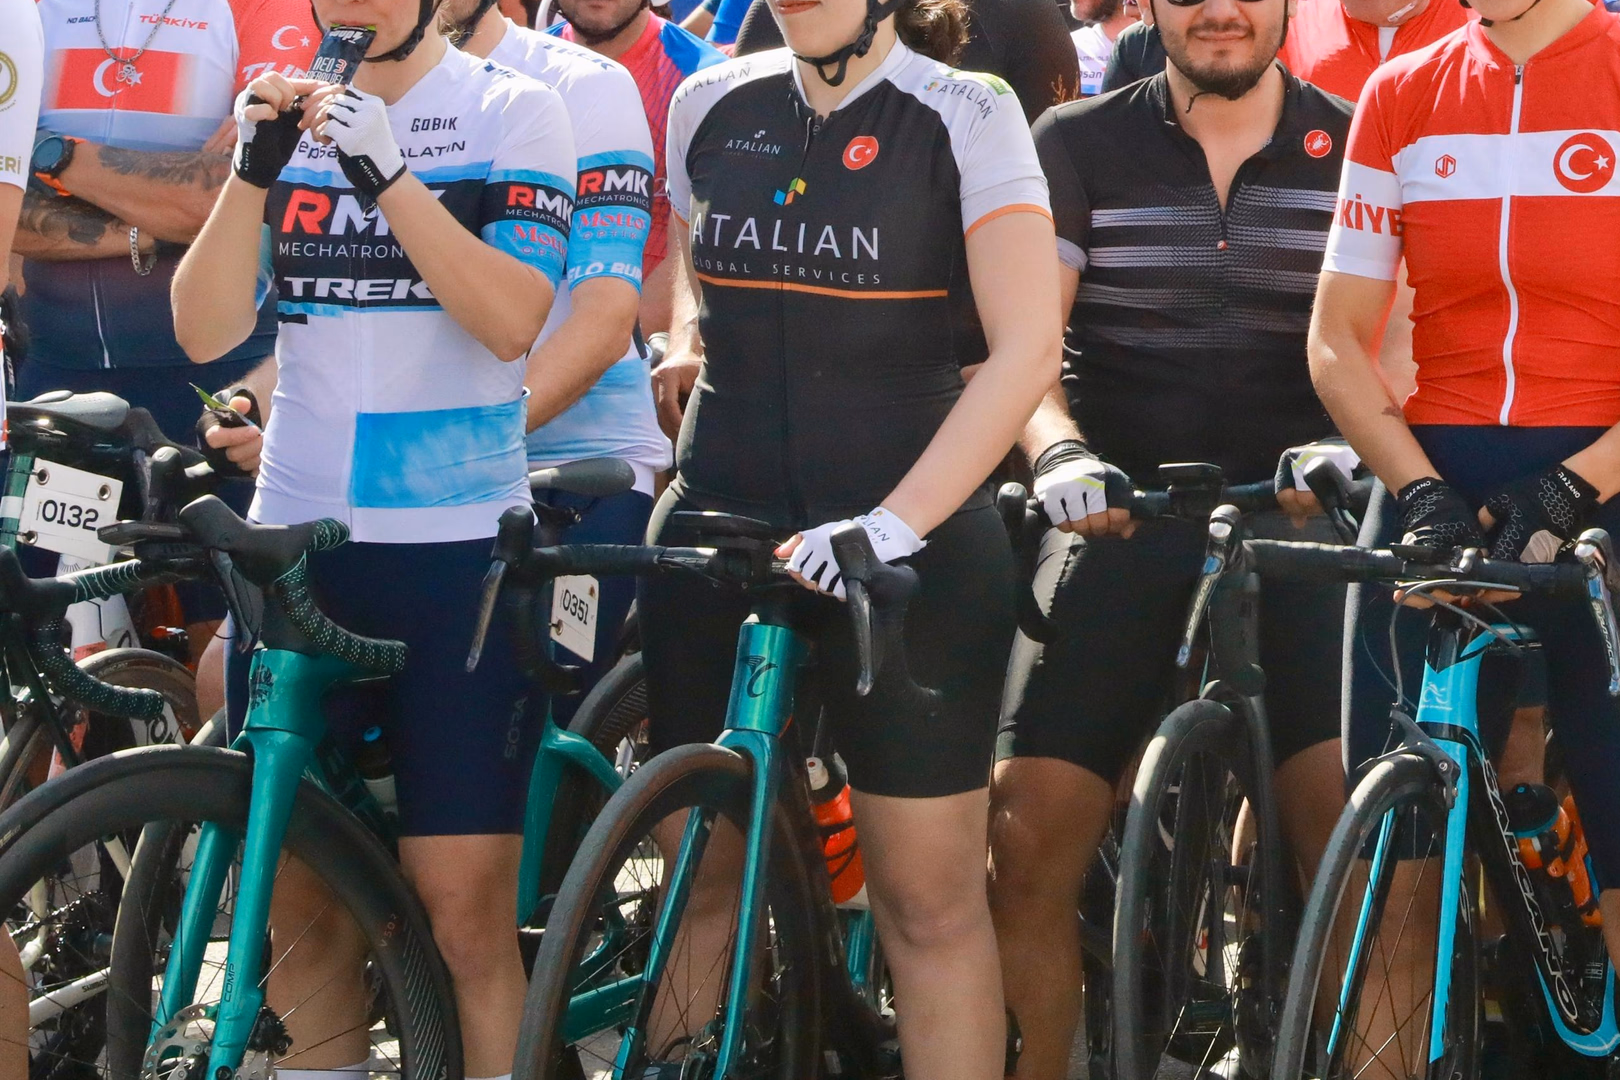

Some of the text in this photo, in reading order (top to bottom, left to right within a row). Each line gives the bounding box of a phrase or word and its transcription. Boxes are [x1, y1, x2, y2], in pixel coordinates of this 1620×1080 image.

[139, 15, 208, 30] TÜRKİYE
[333, 59, 347, 73] 3
[938, 84, 993, 119] ATALIAN
[298, 141, 339, 159] epsa
[399, 140, 465, 158] ALATIN
[725, 139, 781, 155] ATALIAN
[578, 170, 649, 197] RMK
[282, 190, 447, 236] RM
[507, 185, 574, 228] RMK
[576, 195, 650, 208] MECHATRONICS
[1333, 194, 1401, 237] KİYE
[692, 212, 880, 261] ATALIAN
[279, 243, 404, 259] MECHATRON
[694, 258, 881, 286] GLOBAL SERVICES
[284, 277, 434, 301] TREK
[42, 499, 100, 532] 0132
[563, 589, 588, 626] 0351
[224, 963, 236, 1002] COMP
